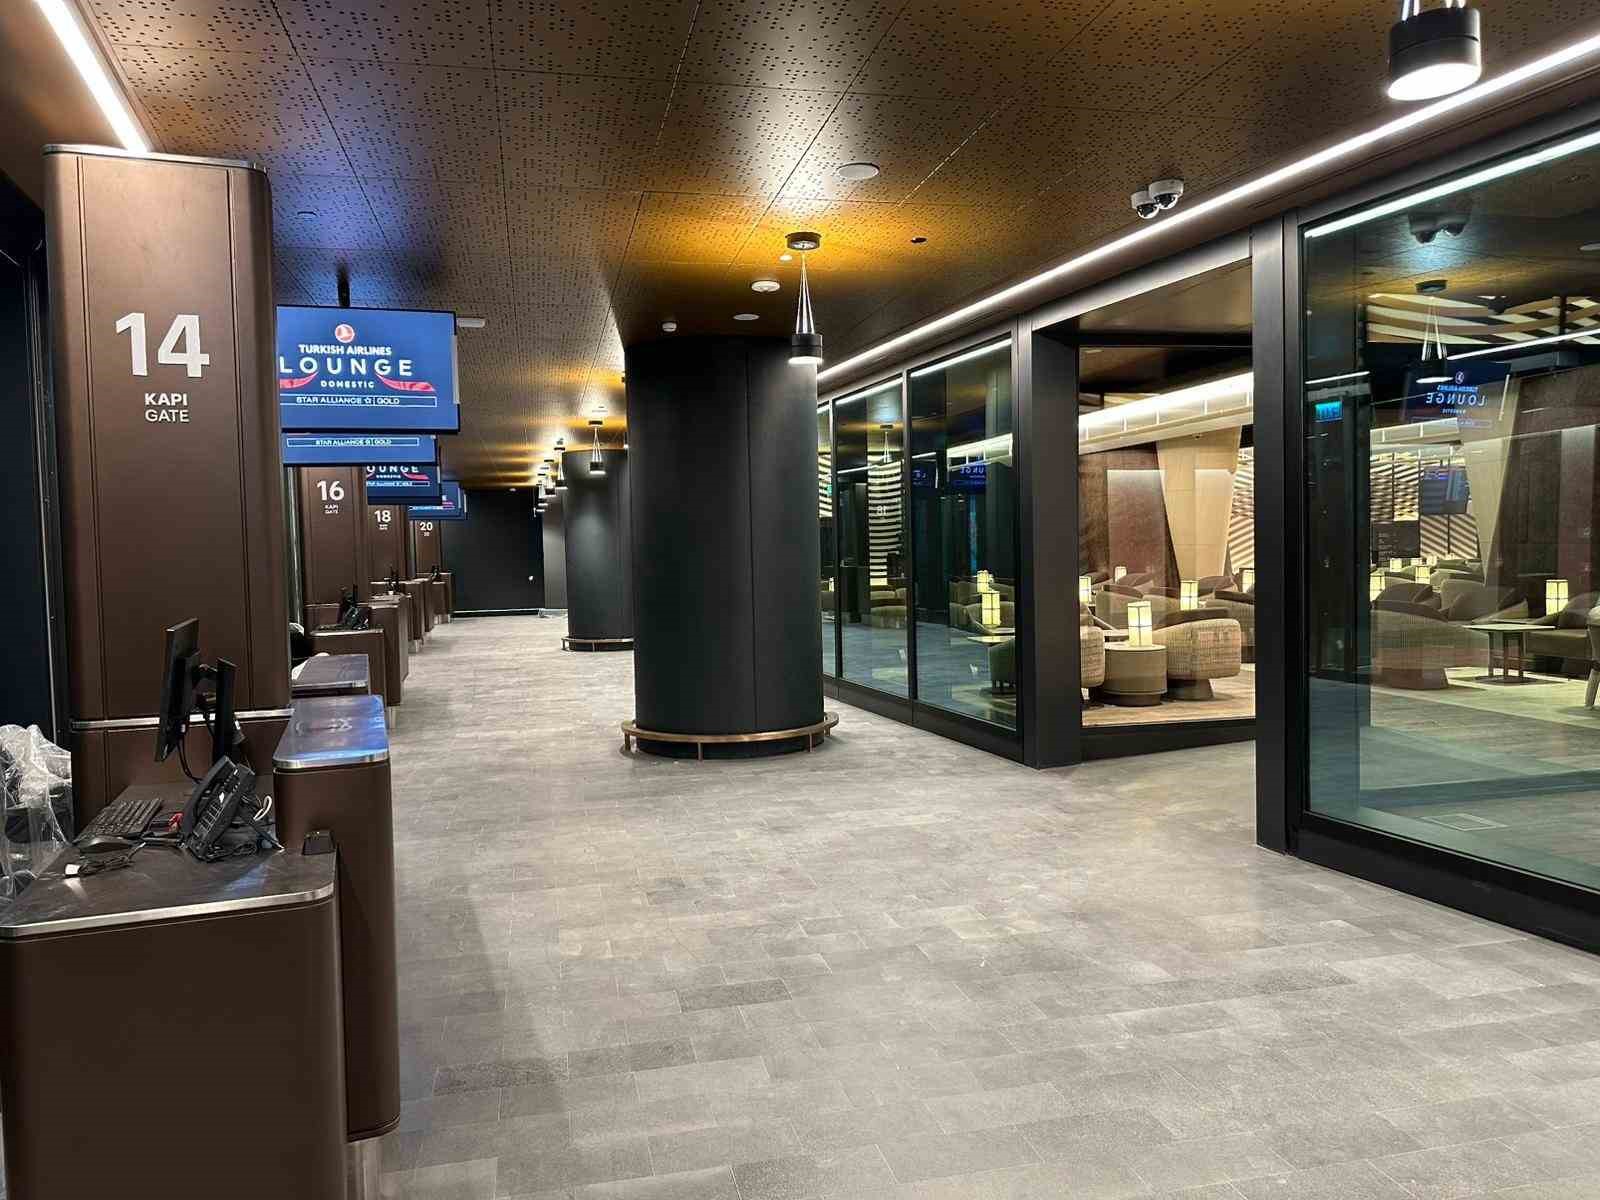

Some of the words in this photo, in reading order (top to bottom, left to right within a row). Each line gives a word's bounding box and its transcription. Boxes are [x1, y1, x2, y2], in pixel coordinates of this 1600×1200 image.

[116, 313, 210, 378] 14
[299, 344, 344, 355] TURKISH
[346, 345, 392, 356] AIRLINES
[280, 356, 412, 377] LOUNGE
[144, 393, 188, 406] KAPI
[296, 396, 319, 405] STAR
[319, 397, 363, 406] ALLIANCE
[376, 398, 401, 407] GOLD
[145, 409, 190, 422] GATE
[317, 480, 345, 501] 16
[374, 510, 392, 523] 18
[419, 522, 433, 531] 20
